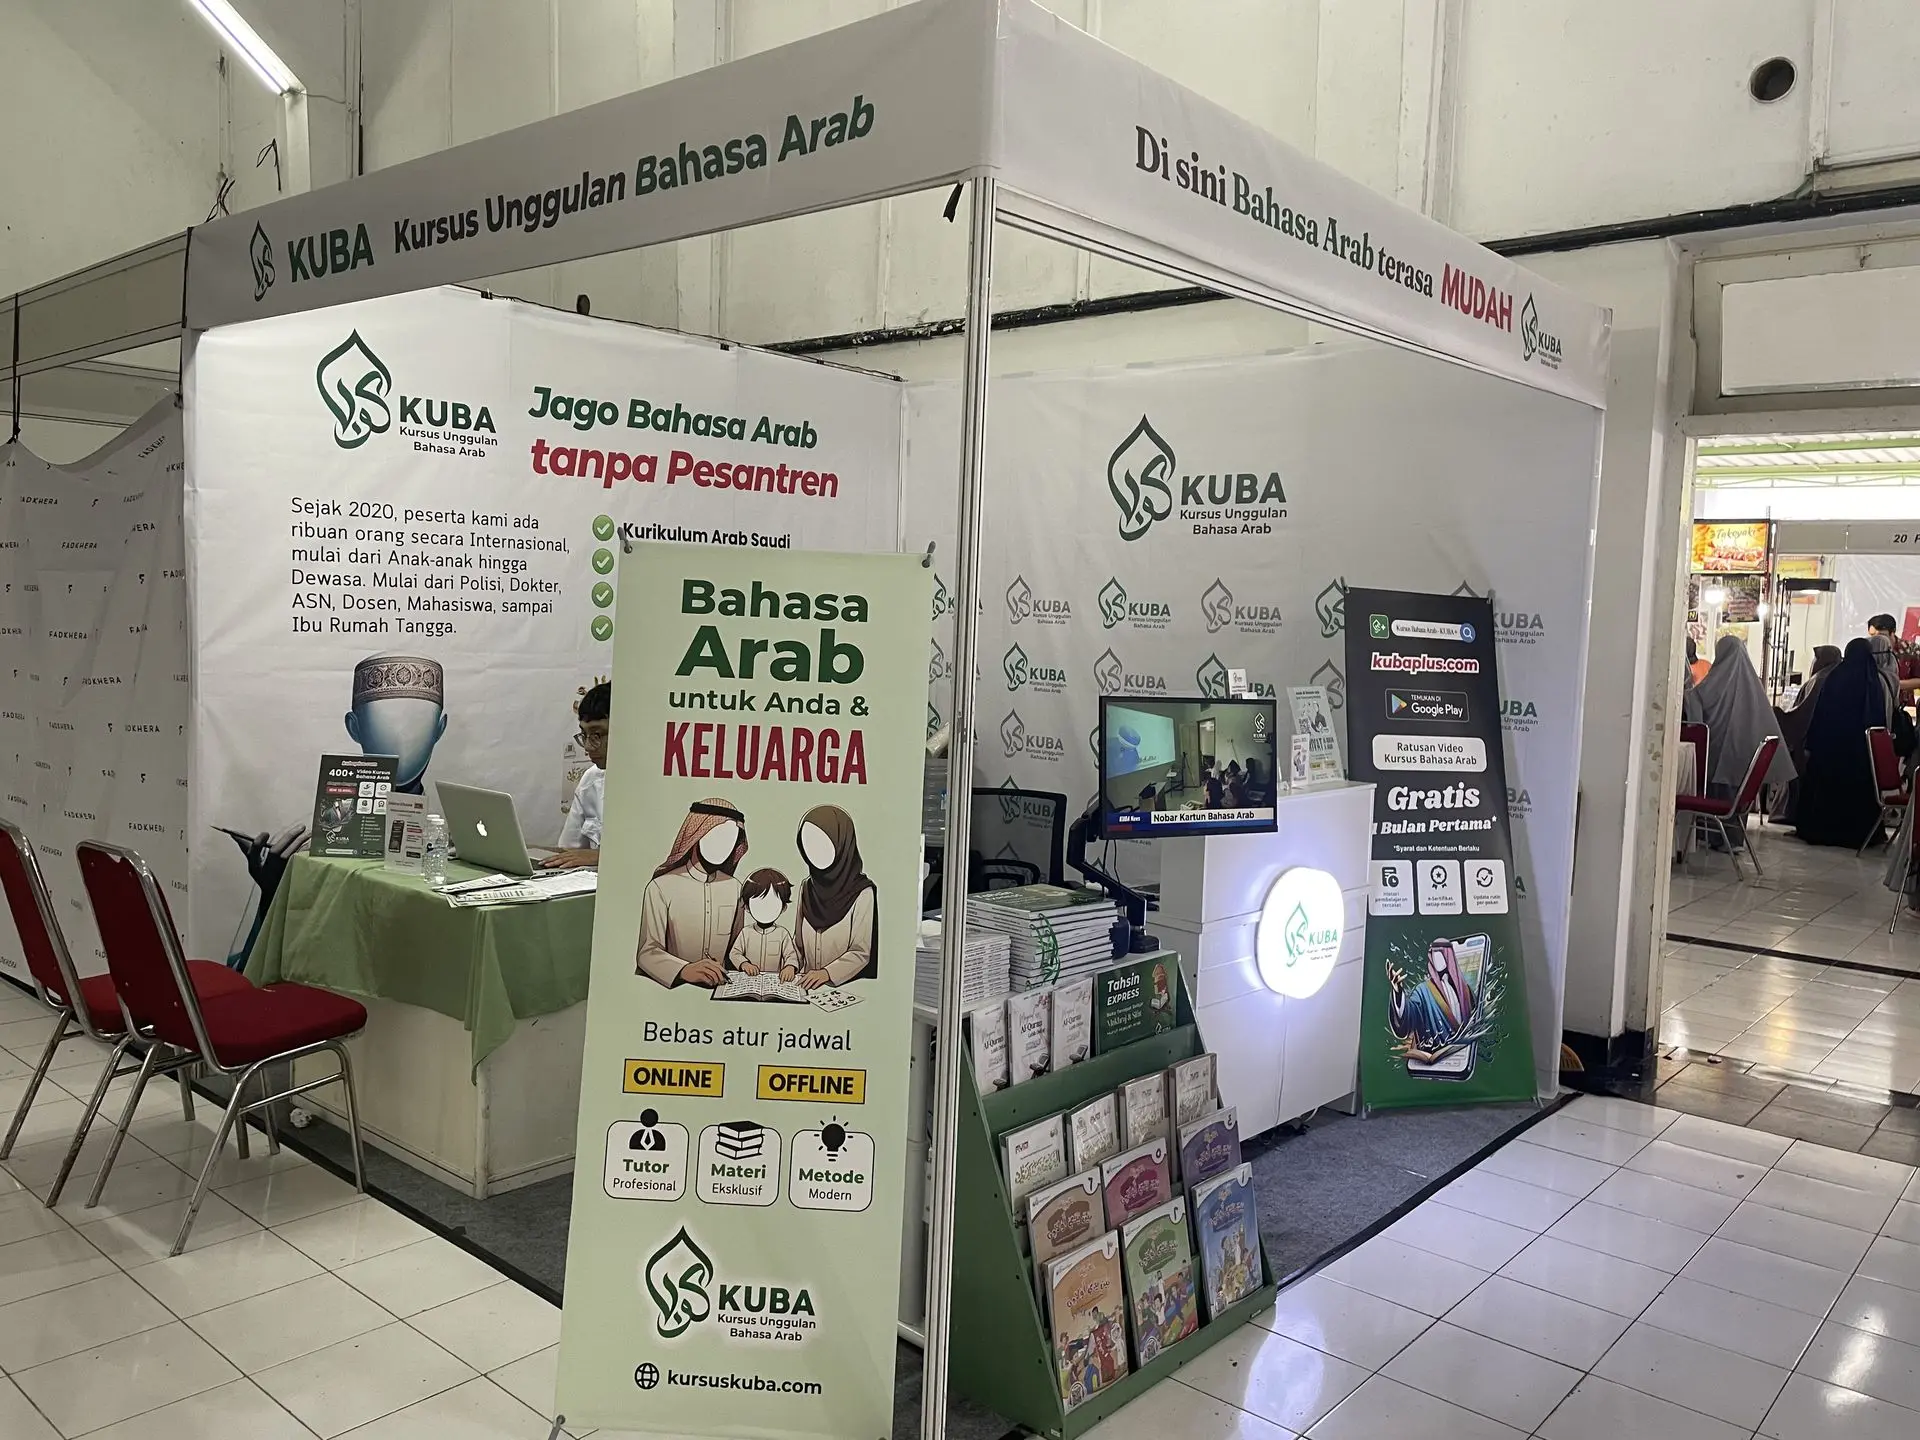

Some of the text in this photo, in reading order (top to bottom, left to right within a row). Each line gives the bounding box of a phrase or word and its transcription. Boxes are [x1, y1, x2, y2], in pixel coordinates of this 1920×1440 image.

[287, 95, 874, 284] KUBA Kursus Unggulan Bahasa Arab
[1135, 125, 1512, 333] Di sini Bahasa Arab terasa MUDAH
[1538, 331, 1561, 356] KUBA
[400, 396, 496, 433] KUBA
[528, 386, 818, 449] Jago Bahasa Arab
[400, 427, 497, 446] Kursus Unggulan
[414, 442, 485, 458] Bahasa Arab
[531, 438, 839, 498] tanpa Pesantren
[1180, 472, 1287, 506] KUBA
[291, 497, 539, 530] Sejak 2020, peserta kami ada
[1180, 507, 1288, 522] Kursus Unggulan
[622, 522, 791, 549] Kurikulum Arab Saudi
[1193, 523, 1272, 536] Bahasa Arab
[291, 523, 570, 554] ribuan orang secara Internasional,
[1893, 534, 1908, 543] 20
[291, 547, 527, 574] mulai dari Anak-anak hingga
[291, 569, 562, 594] Dewasa. Mulai dari Polisi, Dokter,
[291, 593, 553, 616] ASN, Dosen, Mahasiswa, sampai
[681, 579, 869, 623] Bahasa
[1033, 600, 1071, 613] KUBA
[1128, 603, 1171, 617] KUBA
[1235, 605, 1282, 621] KUBA
[292, 616, 457, 637] Ibu Rumah Tangga.
[674, 625, 865, 684] Arab
[1371, 652, 1479, 674] kubaplus.com
[1029, 667, 1066, 682] KUBA
[1124, 674, 1166, 690] KUBA
[1248, 683, 1276, 698] BA
[669, 689, 870, 717] untuk Anda &
[1411, 702, 1463, 718] Google Play
[1500, 700, 1537, 717] UBA
[1026, 735, 1063, 750] KUBA
[1397, 742, 1463, 753] Ratusan Video
[663, 721, 868, 785] KELUARGA
[1384, 754, 1477, 766] Kursus Bahasa Arab
[329, 769, 354, 777] 400+
[1387, 781, 1480, 811] Gratis
[1507, 788, 1531, 805] BA
[1153, 811, 1255, 822] Nobar Kartun Bahasa Arab
[1381, 820, 1426, 835] Bulan
[1428, 844, 1457, 852] Ketentuan
[1458, 844, 1480, 852] Berlaku
[1309, 929, 1338, 946] KUBA
[1107, 972, 1140, 993] Tahsin
[1107, 988, 1140, 1006] EXPRESS
[643, 1021, 852, 1053] Bebas atur jadwal
[633, 1067, 712, 1089] ONLINE
[768, 1073, 854, 1095] OFFLINE
[623, 1158, 670, 1175] Tutor
[711, 1163, 766, 1179] Materi
[613, 1177, 677, 1192] Profesional
[799, 1168, 865, 1185] Metode
[711, 1183, 763, 1197] Eksklusif
[808, 1188, 853, 1201] Modern
[718, 1284, 816, 1316] KUBA
[717, 1313, 816, 1330] Kursus Unggulan
[730, 1327, 802, 1341] Bahasa Arab
[667, 1370, 822, 1395] kursuskuba.com
